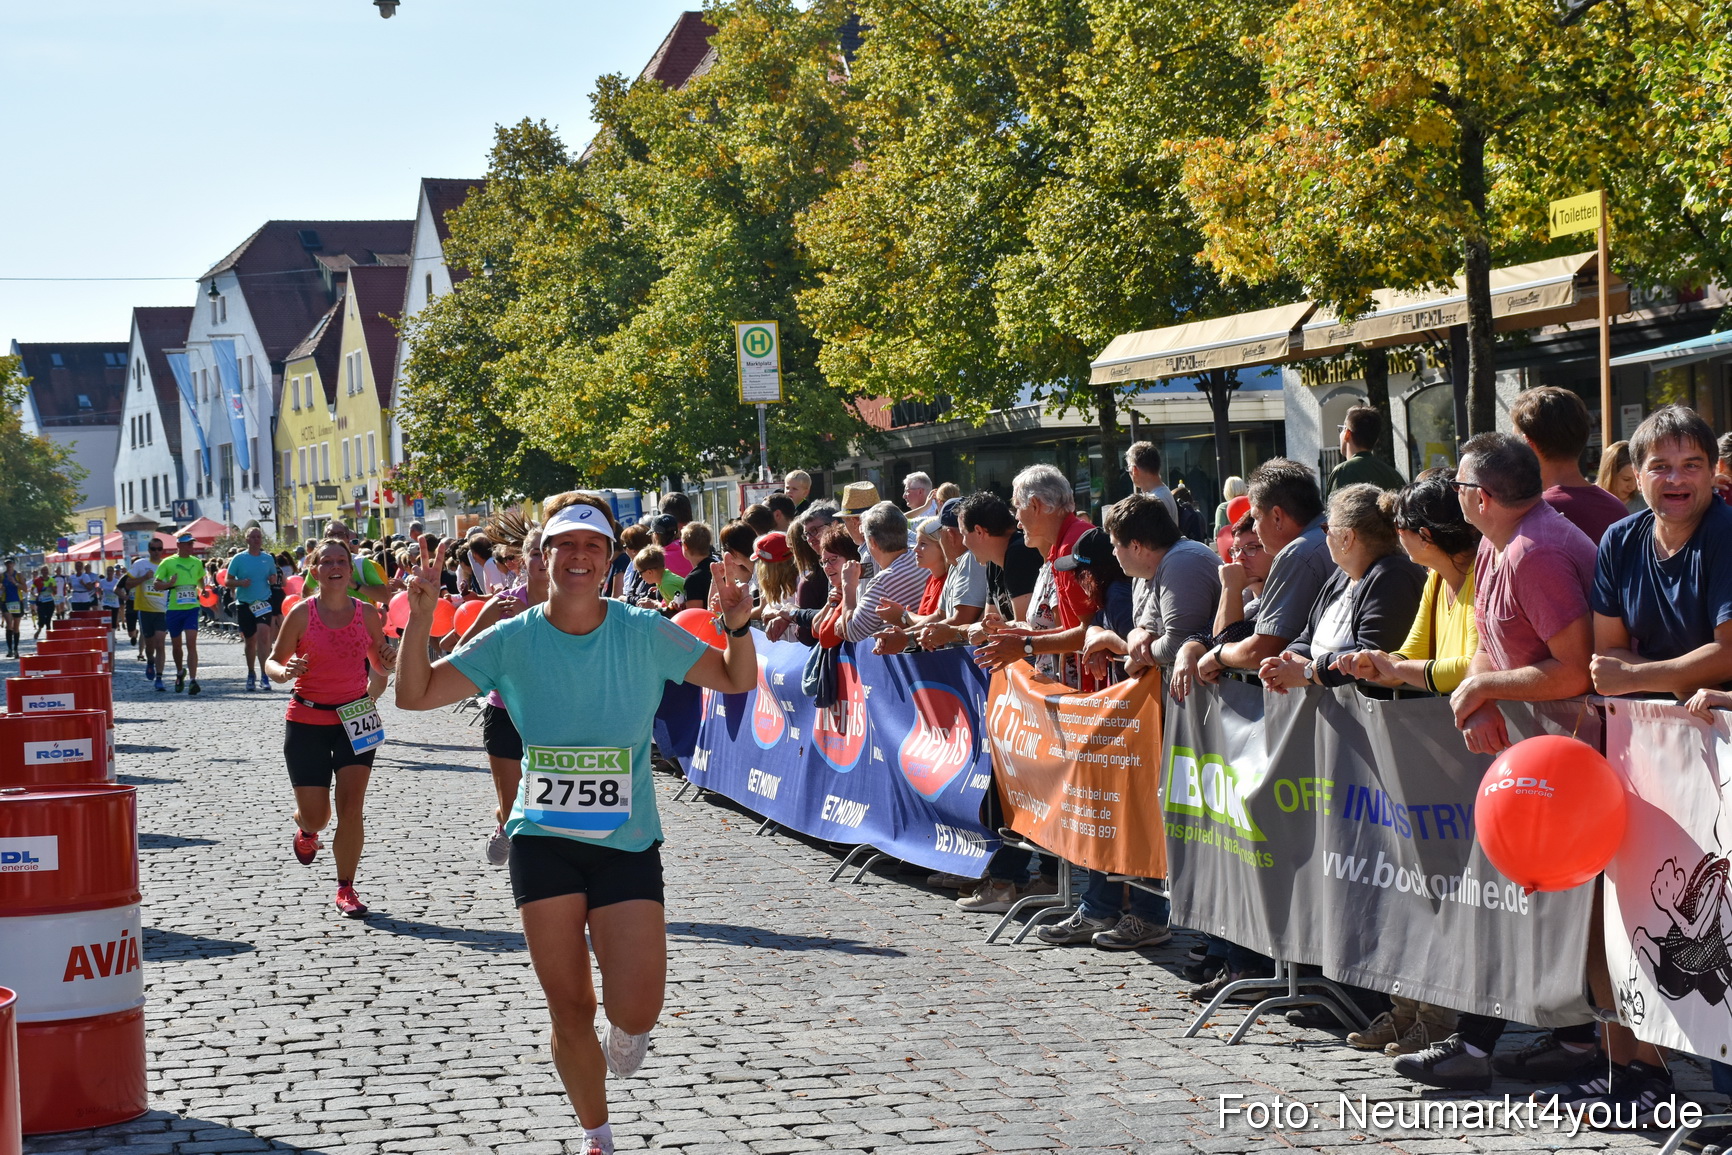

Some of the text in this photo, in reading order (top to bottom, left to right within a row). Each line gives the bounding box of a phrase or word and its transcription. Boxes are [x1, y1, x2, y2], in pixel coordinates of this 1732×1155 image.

[1559, 205, 1598, 225] Toiletten
[751, 333, 765, 351] H
[416, 502, 422, 517] P
[1103, 696, 1130, 709] Partner
[1015, 729, 1042, 760] CLINIC
[1077, 733, 1089, 744] was
[1090, 732, 1127, 748] Internet,
[535, 750, 623, 771] BOCK
[1074, 749, 1108, 768] Werbung
[1109, 752, 1142, 770] angeht.
[908, 761, 931, 779] SPORTS
[747, 767, 761, 794] GET
[1485, 767, 1555, 796] RÖDL
[536, 777, 619, 807] 2758
[1088, 786, 1102, 801] bei
[1103, 791, 1120, 802] uns:
[1515, 788, 1553, 798] energie
[935, 822, 953, 853] GET
[1079, 822, 1096, 837] 8833
[1098, 825, 1117, 839] 897
[1, 851, 39, 864] DL
[1, 861, 39, 872] energie
[63, 929, 140, 982] AVIA
